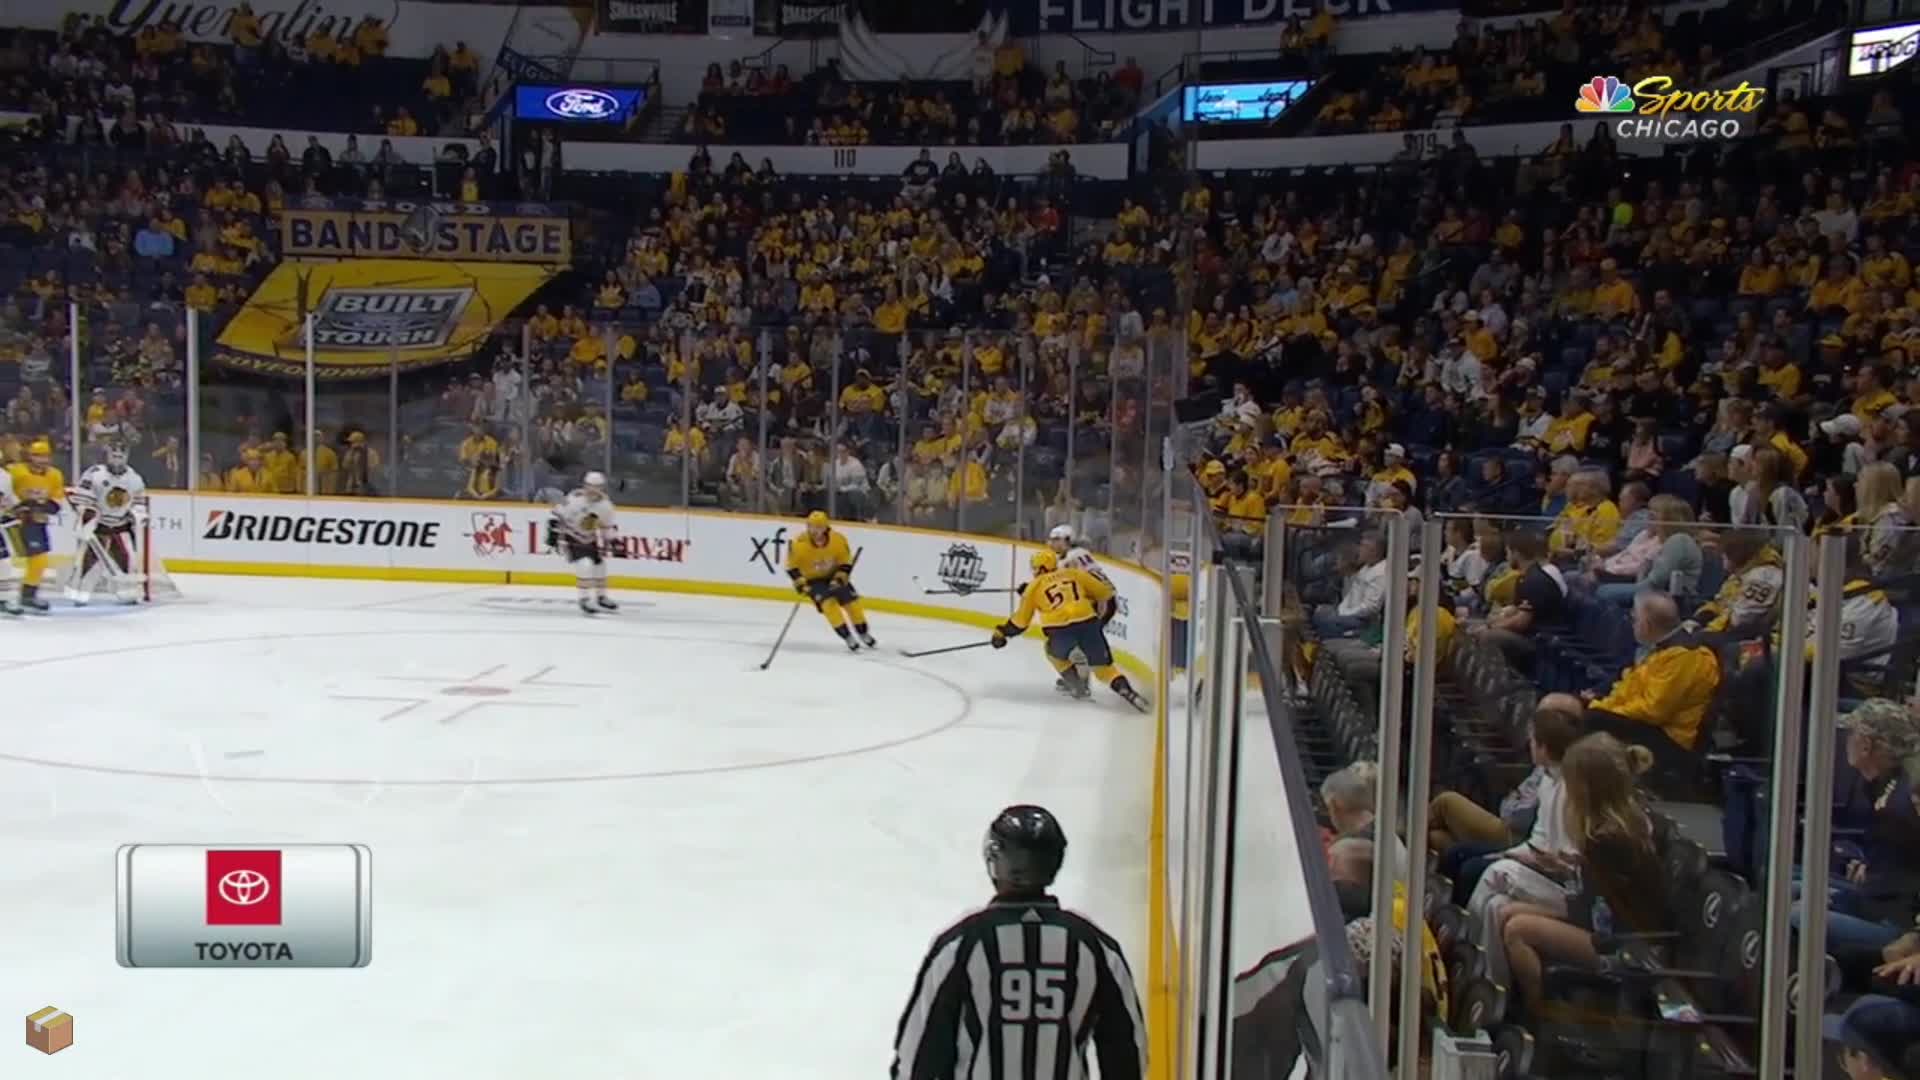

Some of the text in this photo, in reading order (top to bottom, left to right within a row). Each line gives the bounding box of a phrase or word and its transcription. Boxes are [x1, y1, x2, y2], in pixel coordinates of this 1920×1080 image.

[105, 0, 388, 48] Yuenglin
[833, 149, 857, 169] 110
[291, 218, 562, 254] BAND STAGE
[334, 294, 450, 313] BUILT
[315, 328, 434, 345] TOUGH
[202, 510, 441, 548] BRIDGESTONE
[528, 521, 691, 563] Lnvar
[937, 552, 987, 582] NHL
[1043, 579, 1080, 611] 57
[1001, 968, 1067, 1020] 95
